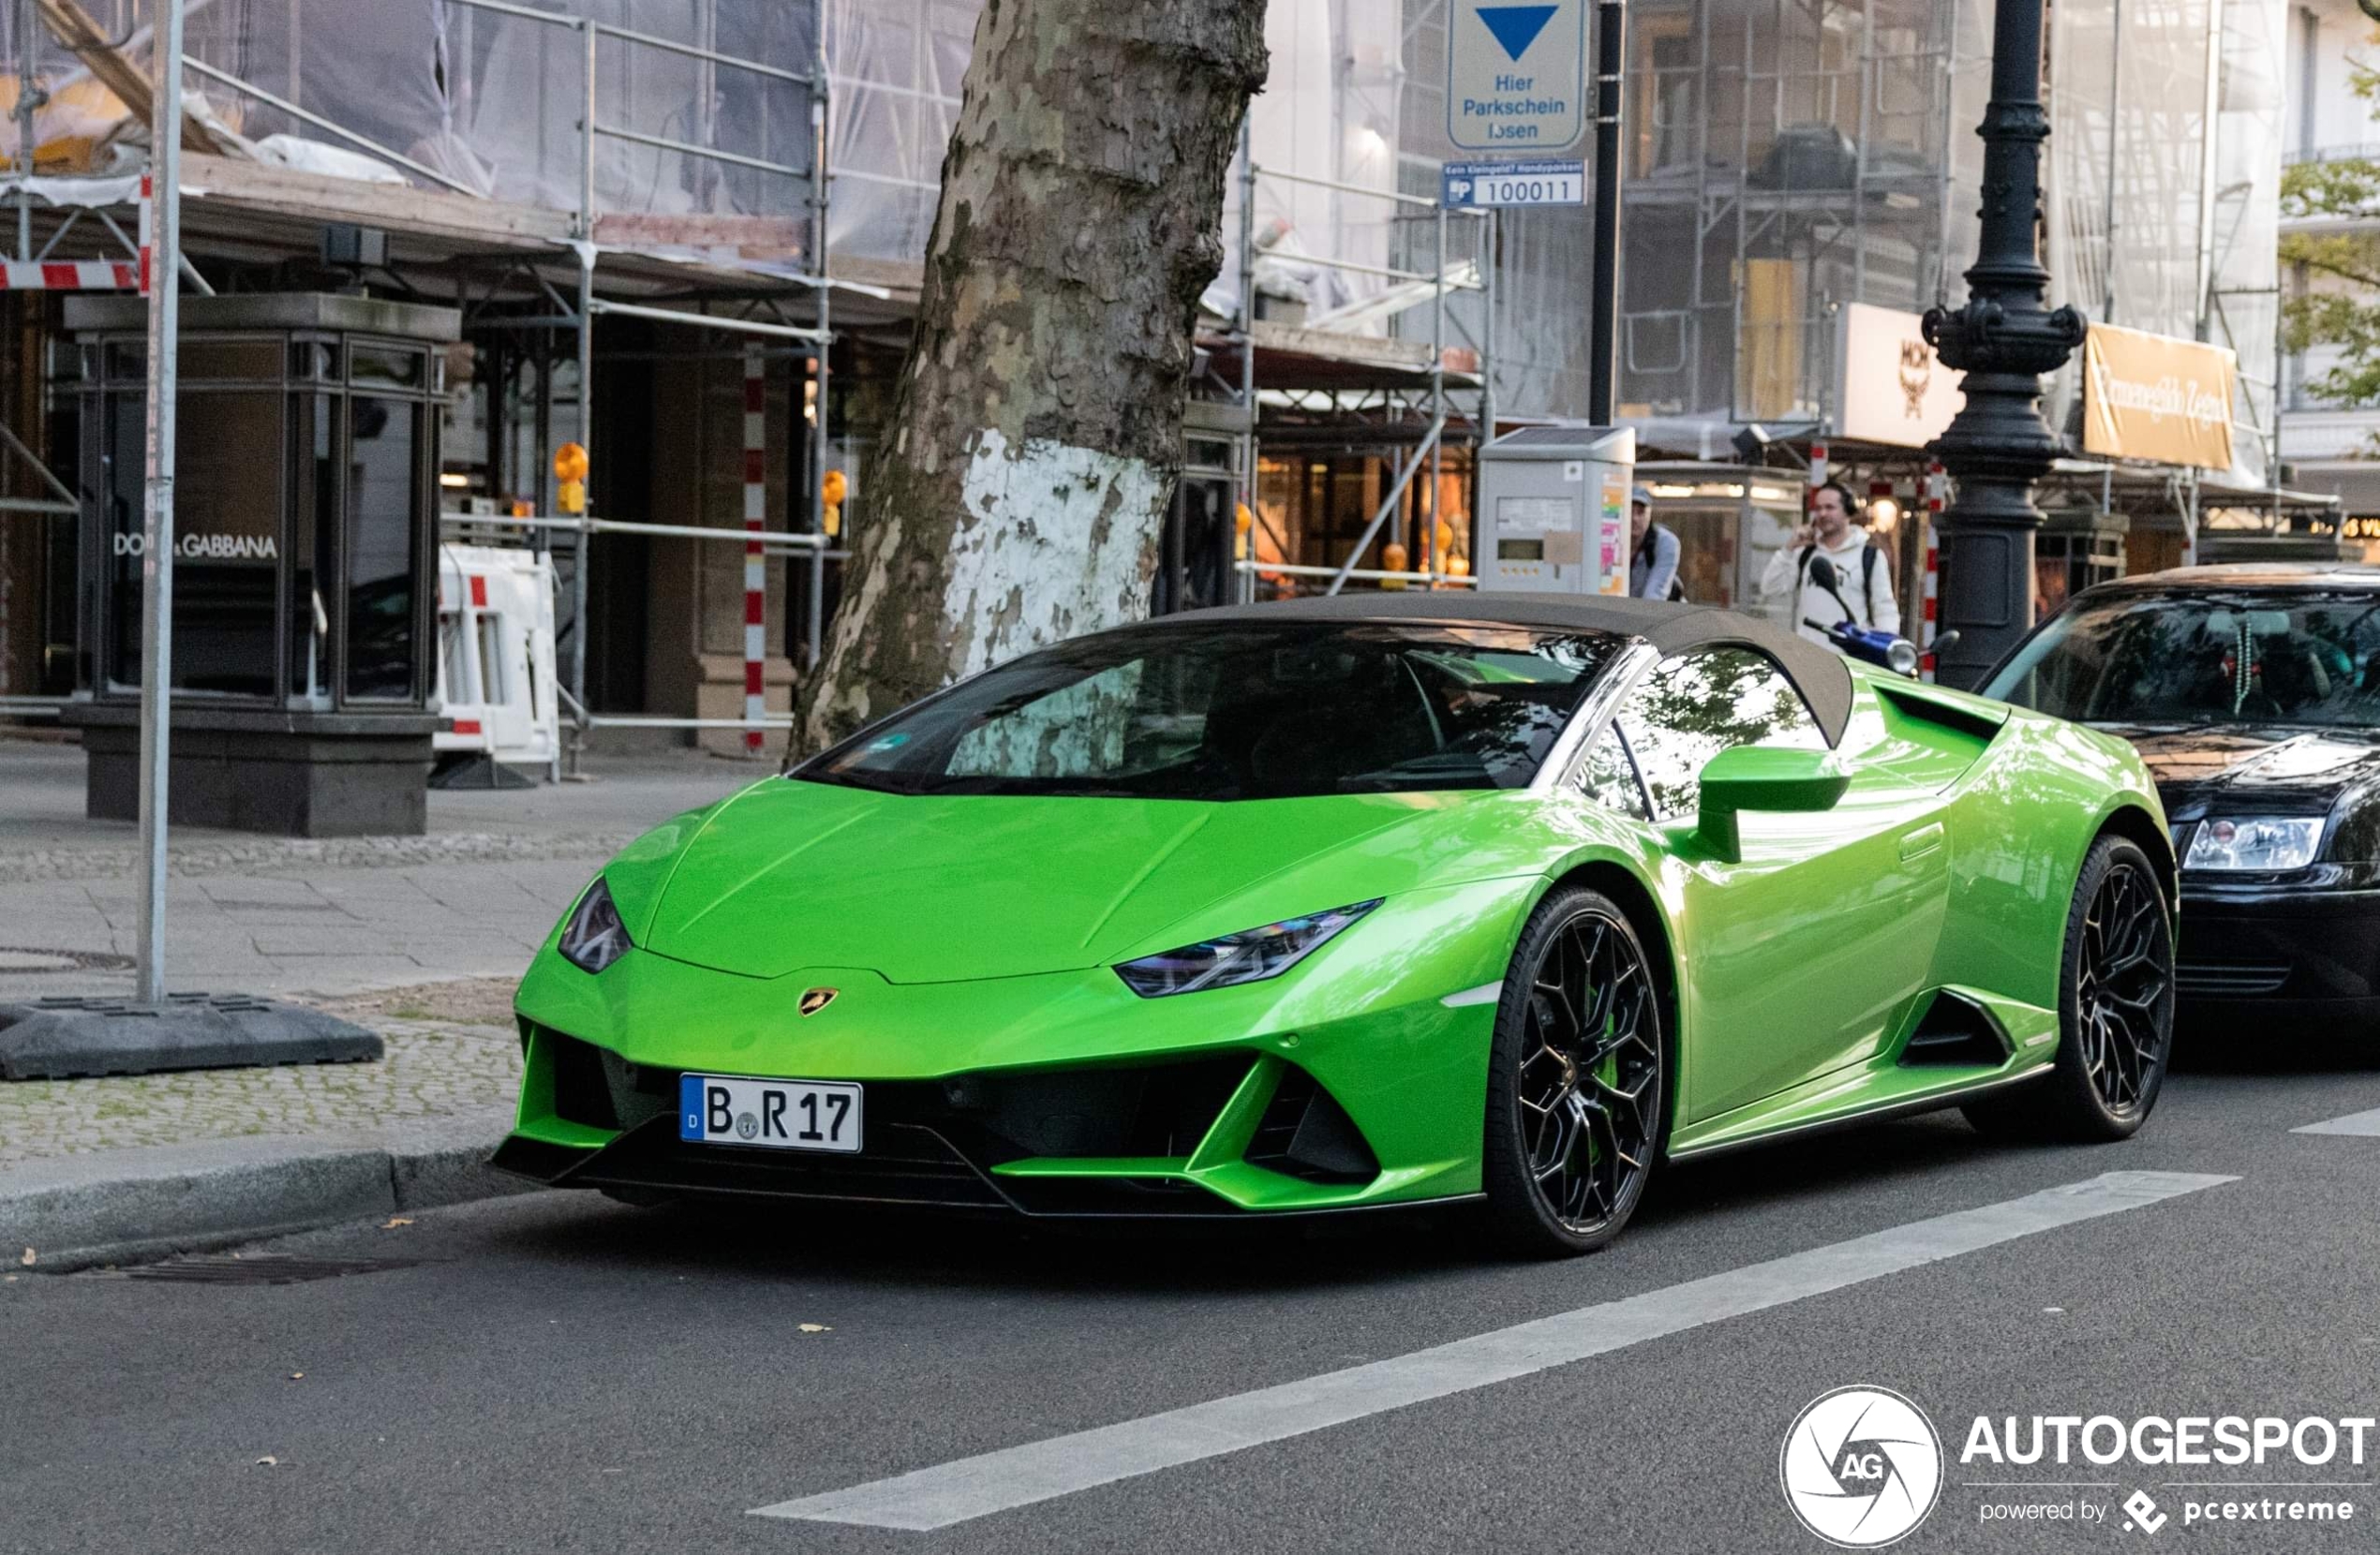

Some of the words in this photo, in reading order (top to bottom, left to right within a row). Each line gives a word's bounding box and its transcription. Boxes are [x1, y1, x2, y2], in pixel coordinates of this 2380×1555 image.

[1495, 75, 1533, 91] Hier
[1464, 97, 1565, 116] Parkschein
[1489, 182, 1569, 201] 100011
[182, 532, 278, 558] GABBANA
[688, 1114, 698, 1129] D
[707, 1086, 733, 1133] B
[763, 1089, 788, 1138] R
[798, 1092, 851, 1141] 17
